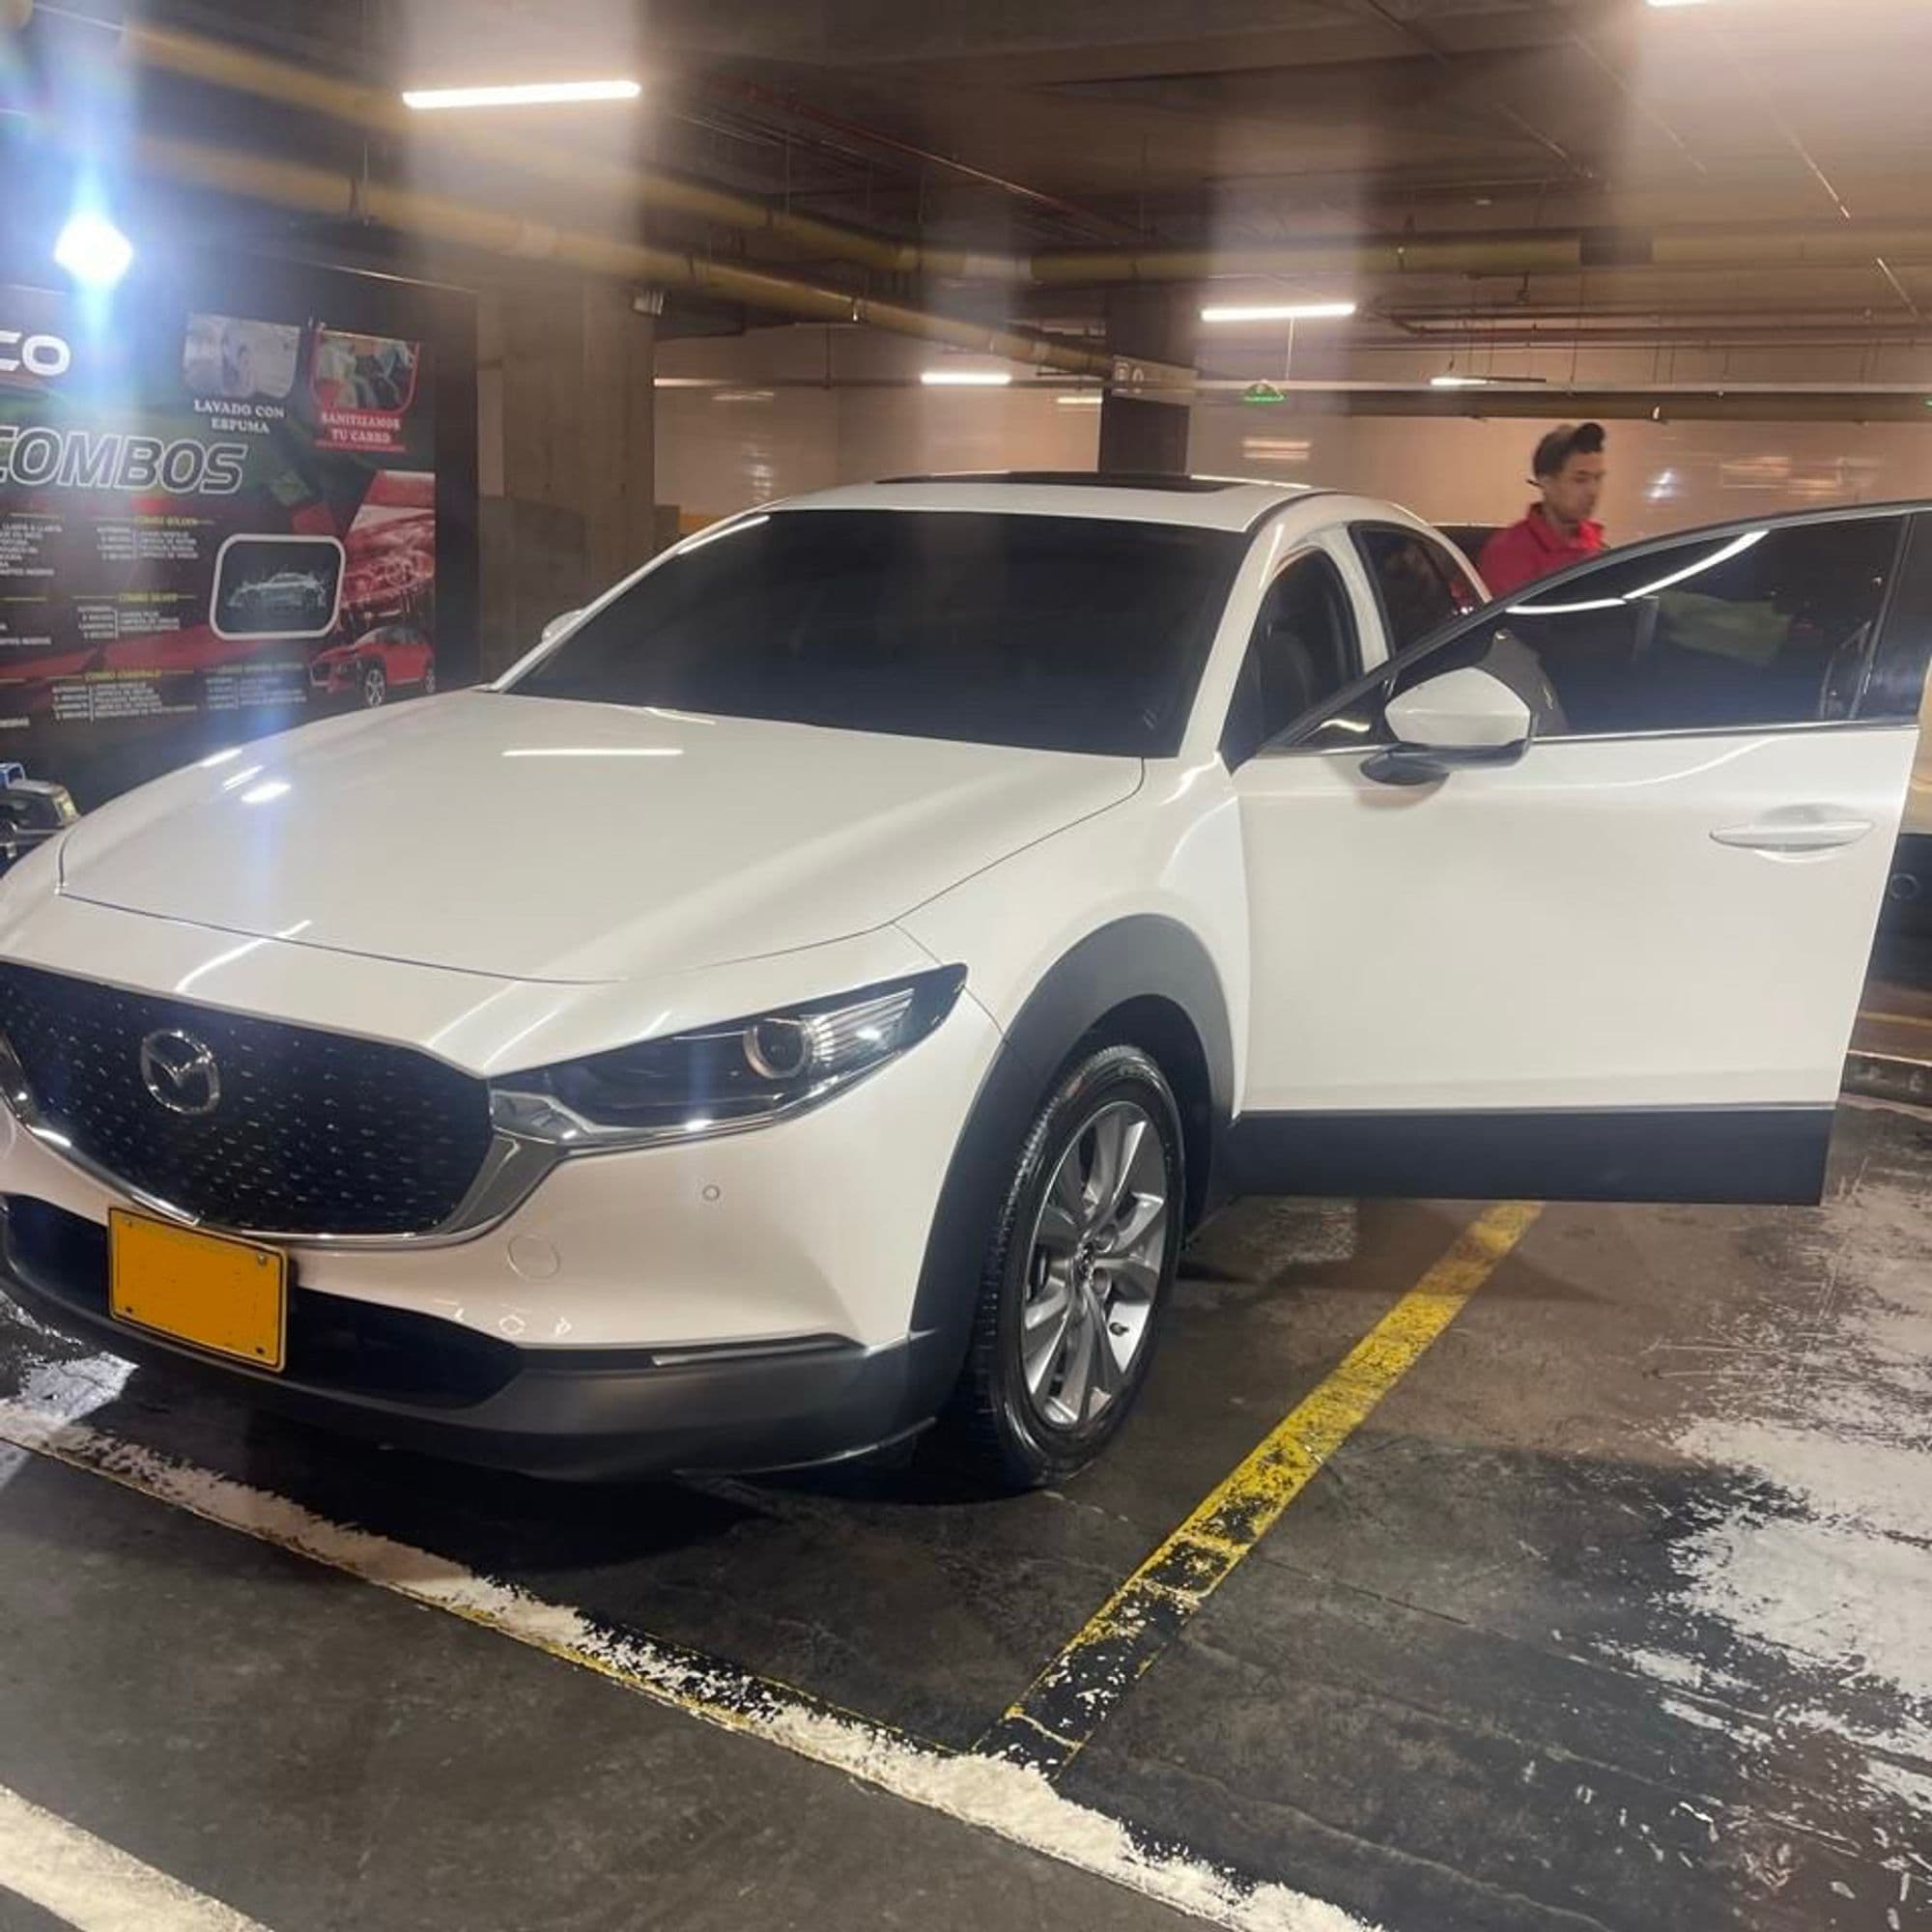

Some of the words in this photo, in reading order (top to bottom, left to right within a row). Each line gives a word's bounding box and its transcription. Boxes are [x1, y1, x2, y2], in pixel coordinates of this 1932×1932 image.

[194, 399, 251, 416] LAVADO
[254, 404, 285, 418] CON
[212, 416, 270, 434] ESPUMA
[331, 428, 348, 440] TU
